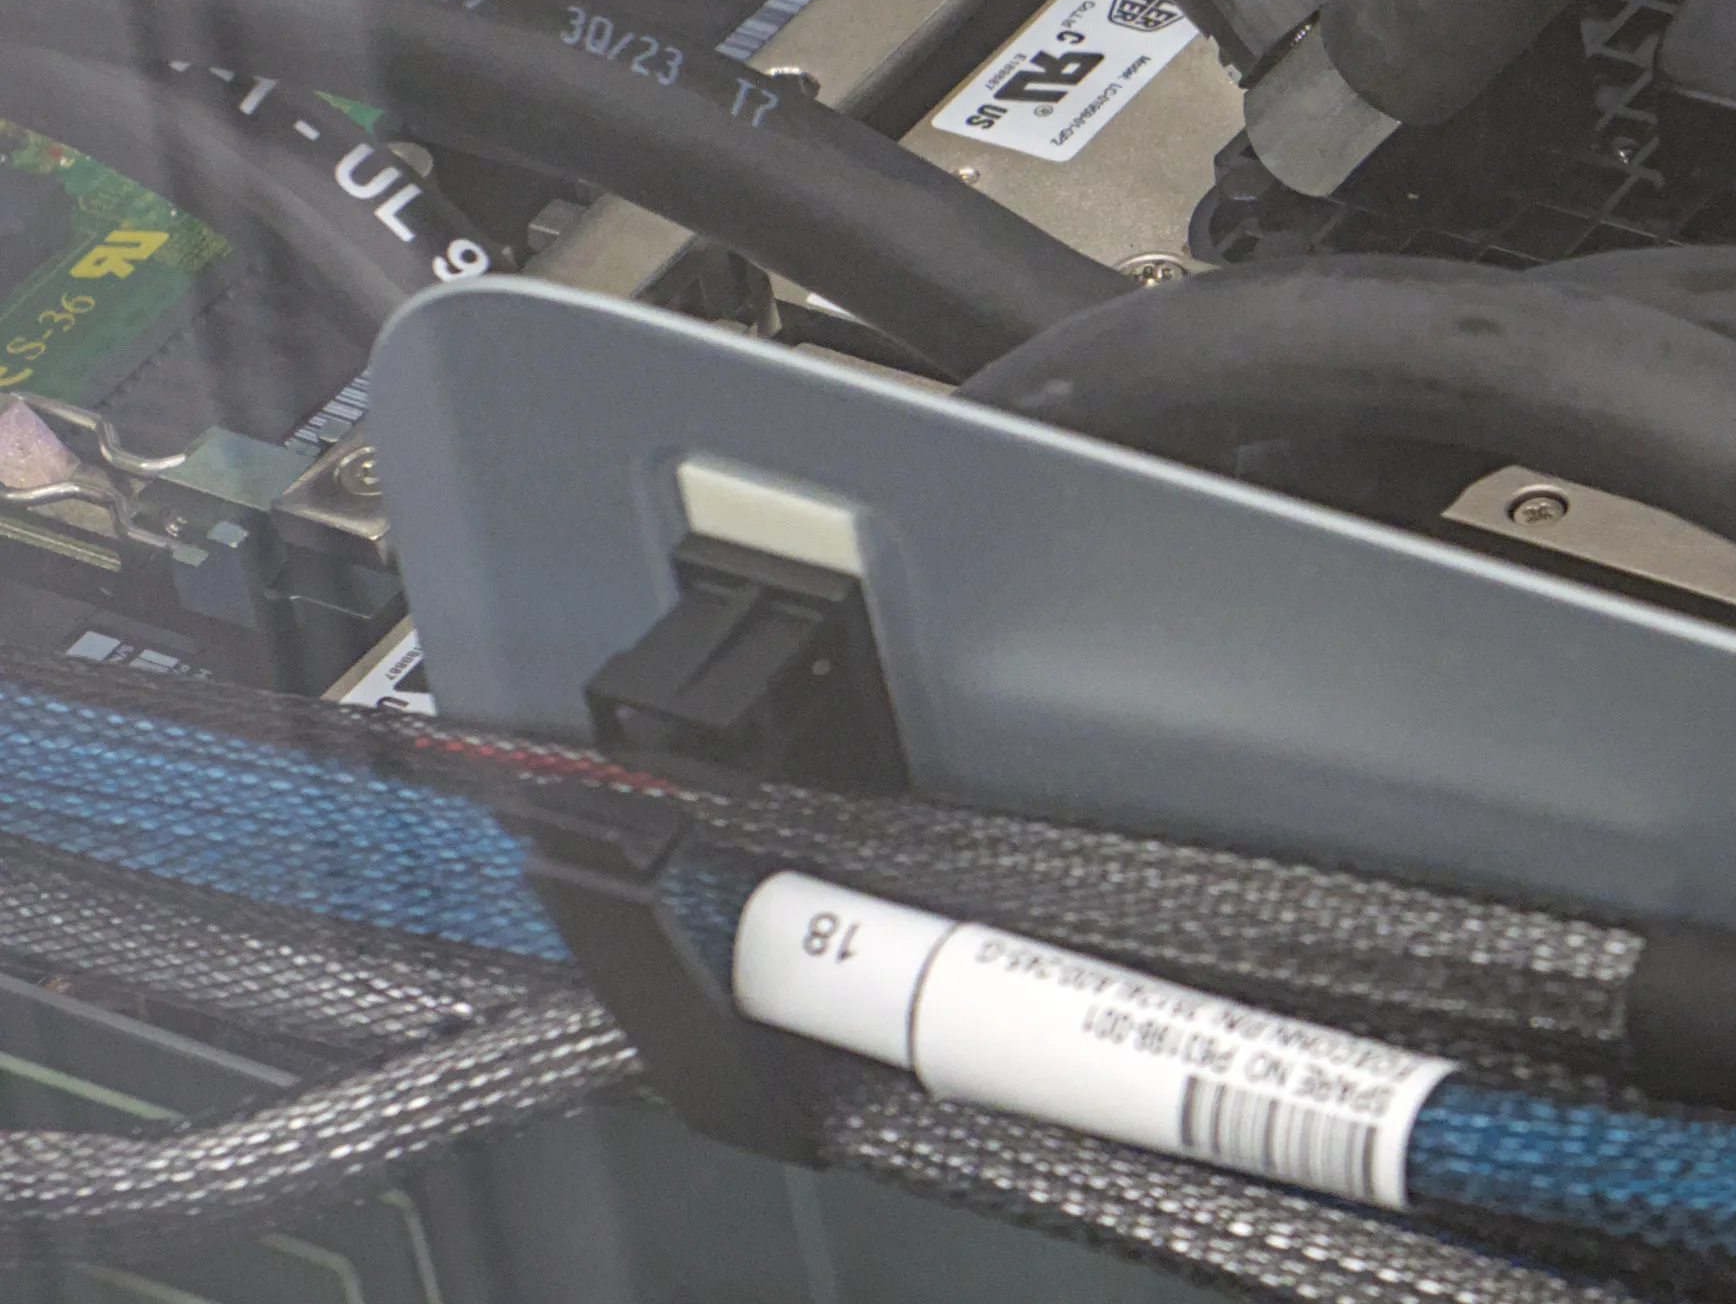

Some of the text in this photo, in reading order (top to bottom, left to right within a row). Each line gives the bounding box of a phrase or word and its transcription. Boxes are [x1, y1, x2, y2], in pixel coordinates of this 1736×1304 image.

[1056, 30, 1087, 46] C
[965, 103, 1009, 130] US
[334, 141, 424, 243] UL
[800, 911, 861, 965] 18
